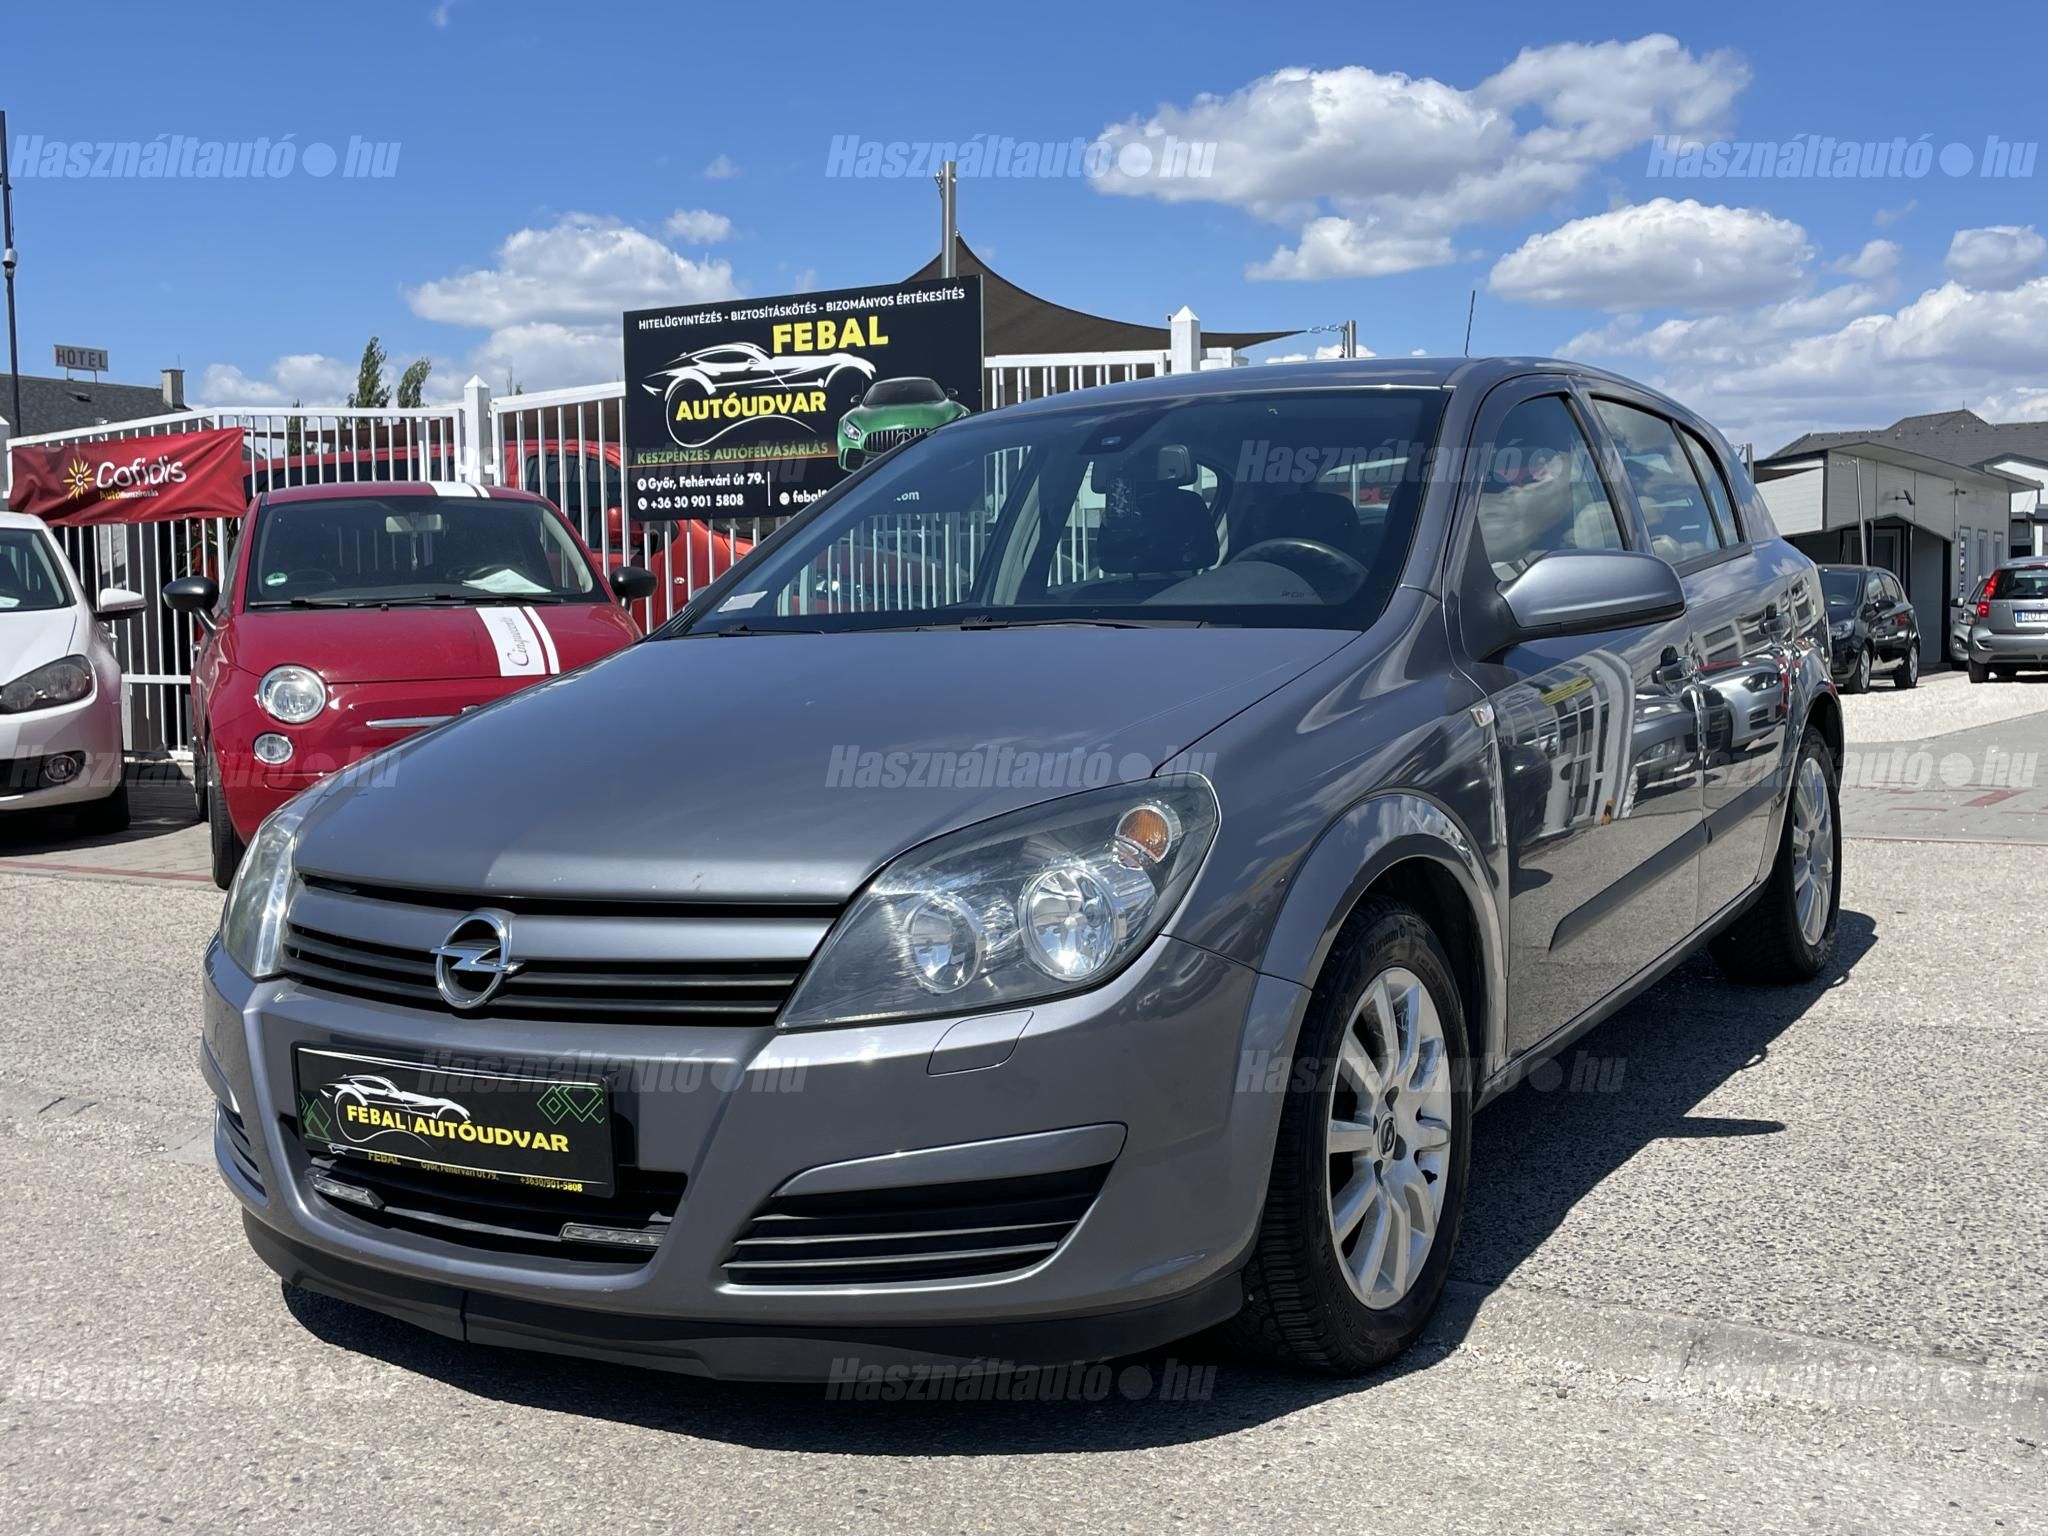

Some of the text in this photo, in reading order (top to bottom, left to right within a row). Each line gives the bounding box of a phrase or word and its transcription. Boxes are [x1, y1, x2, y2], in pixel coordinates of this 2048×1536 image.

[638, 286, 965, 330] HITELÜGYINTÉZÉS BIZTOSÍTÁSKÖTÉS BIZOMÁNYOS ÉRTÉKESÍTÉS
[773, 315, 889, 353] FEBAL
[56, 348, 105, 369] HOTEL
[675, 391, 827, 421] AUTÓUDVAR
[637, 441, 829, 464] KÉSZPÉNZES AUTÓFELVÁSÁRLÁS
[96, 455, 187, 489] Cofidis
[648, 472, 765, 492] Győr, Fehérvári út 79.
[651, 494, 744, 510] +36 30 901 5808
[346, 1105, 570, 1152] FEBAL AUTÓUDVAR
